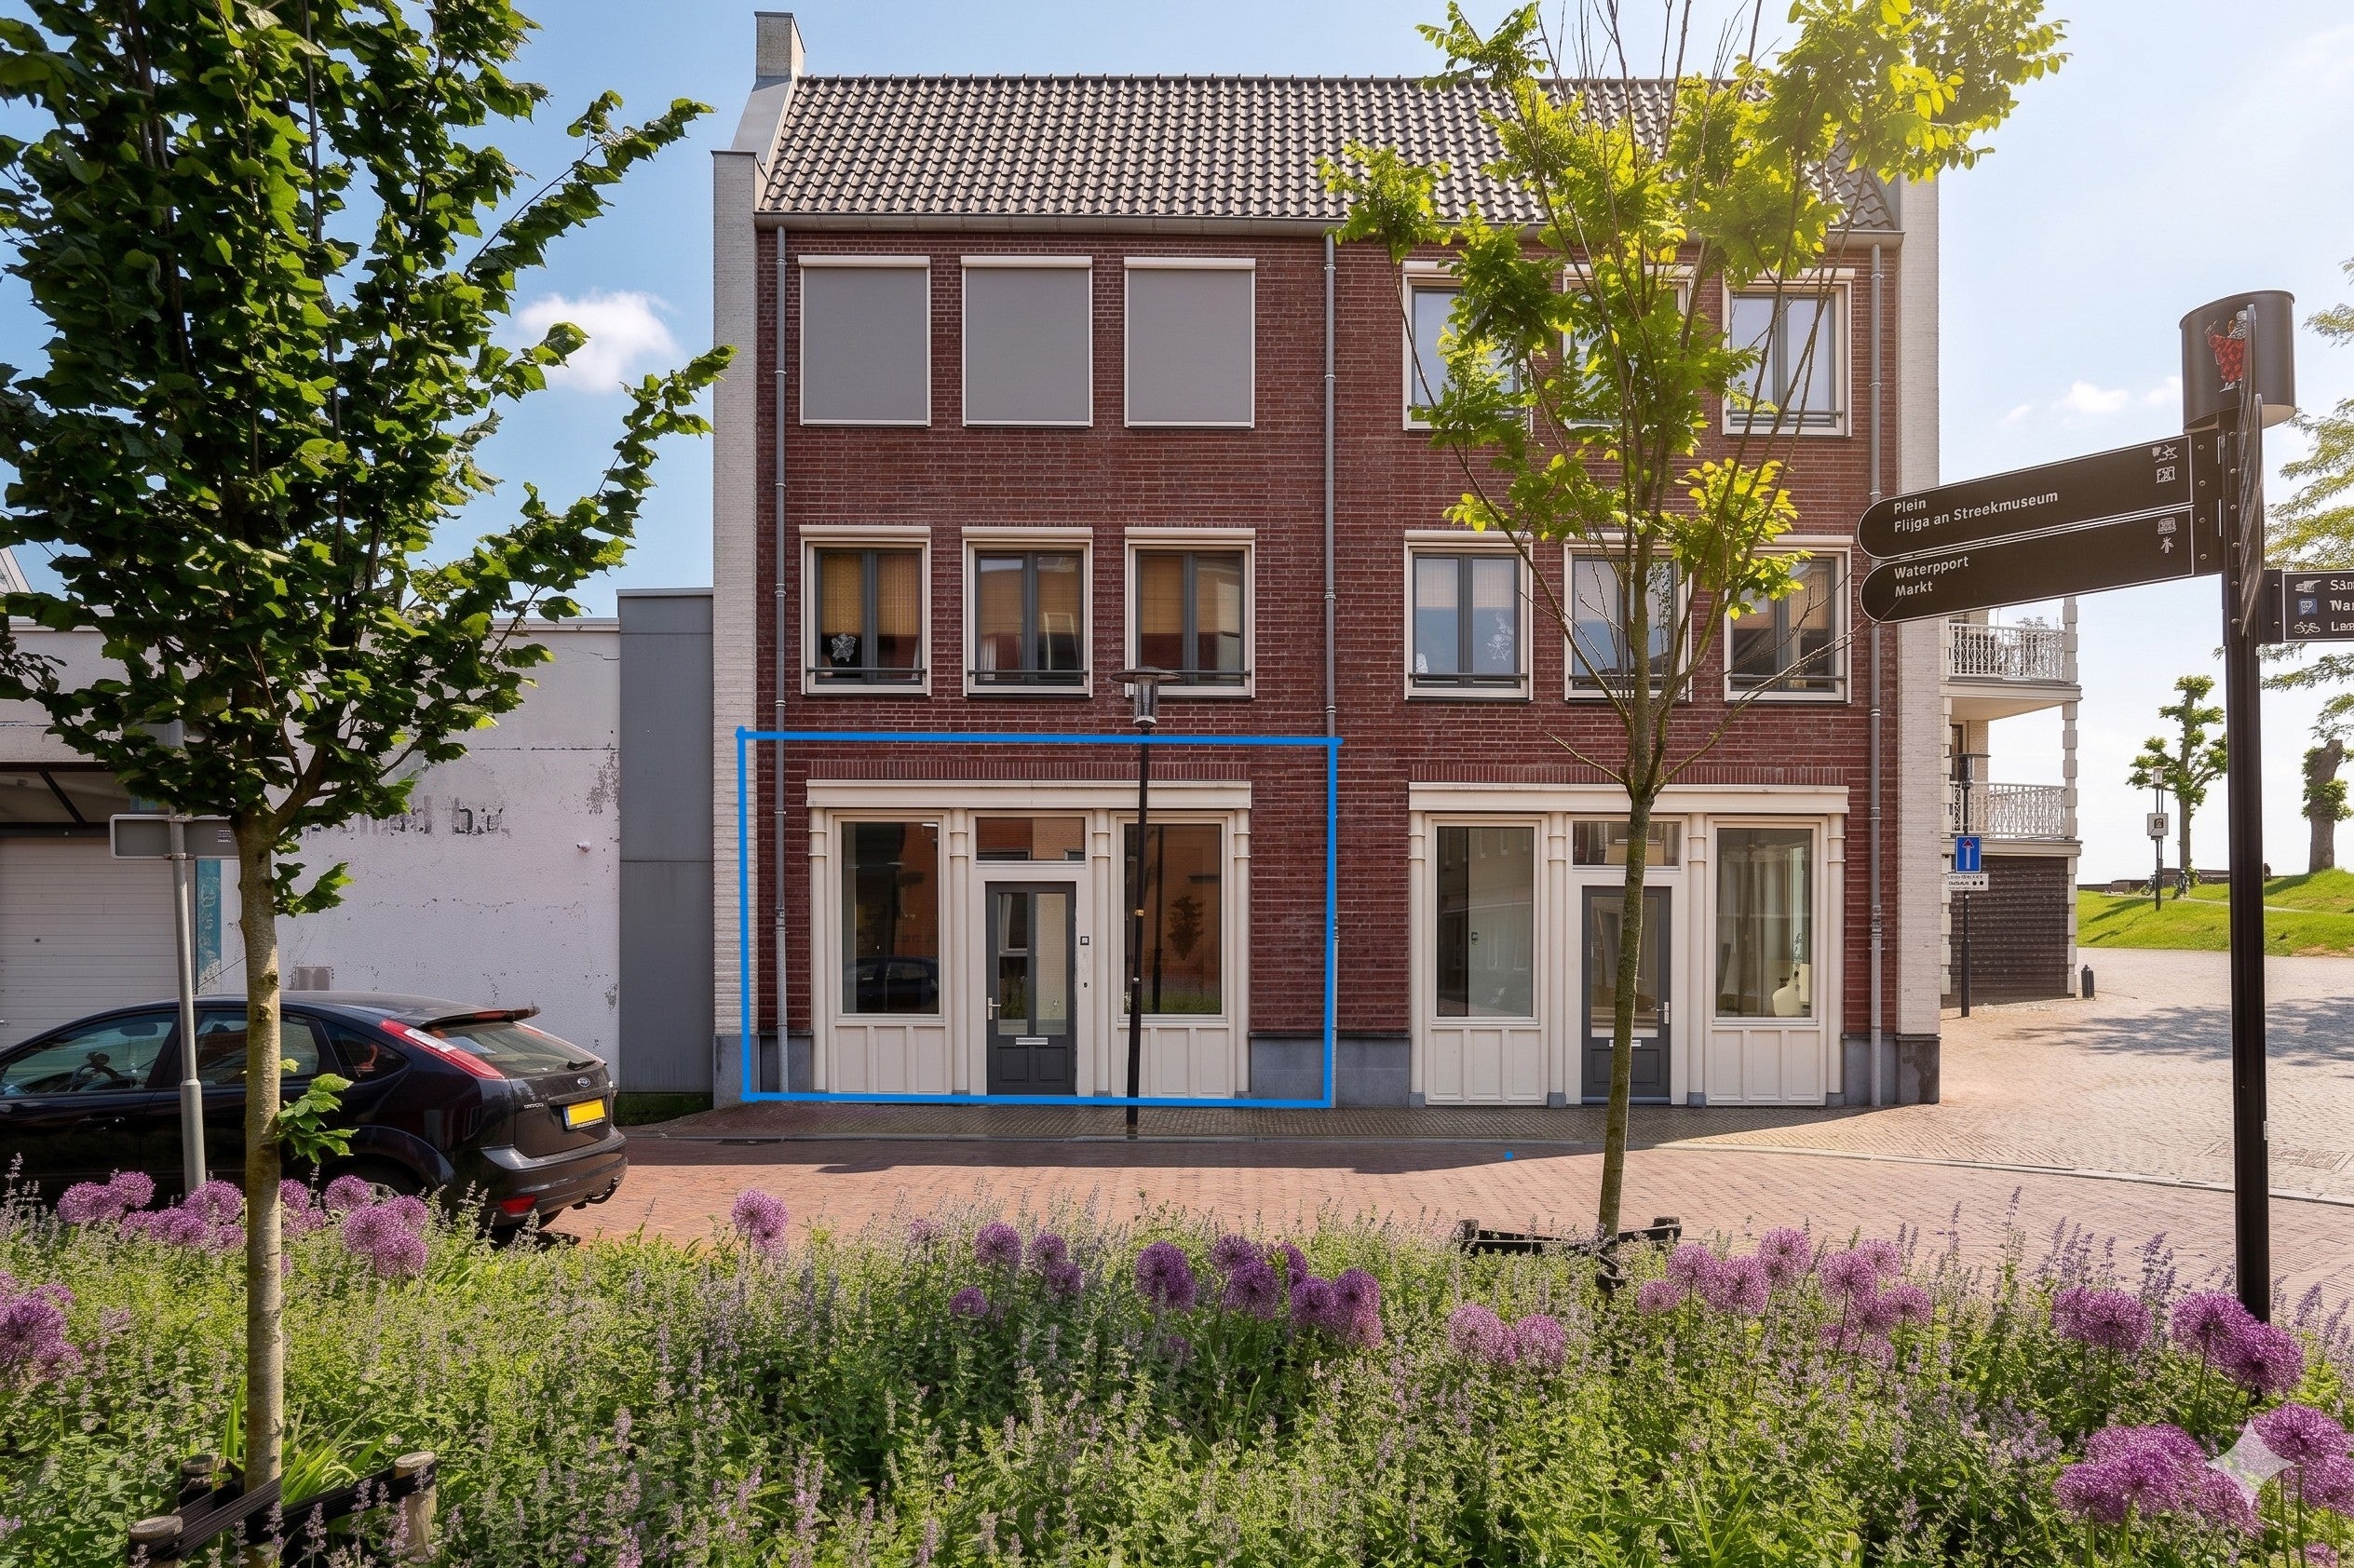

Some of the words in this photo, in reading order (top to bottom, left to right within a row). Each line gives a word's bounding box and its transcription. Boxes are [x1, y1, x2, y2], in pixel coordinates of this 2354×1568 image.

[1894, 498, 1927, 515] Plein
[1894, 517, 1929, 534] Flijga
[1933, 513, 1950, 525] an
[1954, 492, 2059, 521] Streekmuseum
[1894, 556, 1969, 580] Waterpport
[1894, 581, 1933, 598] Markt
